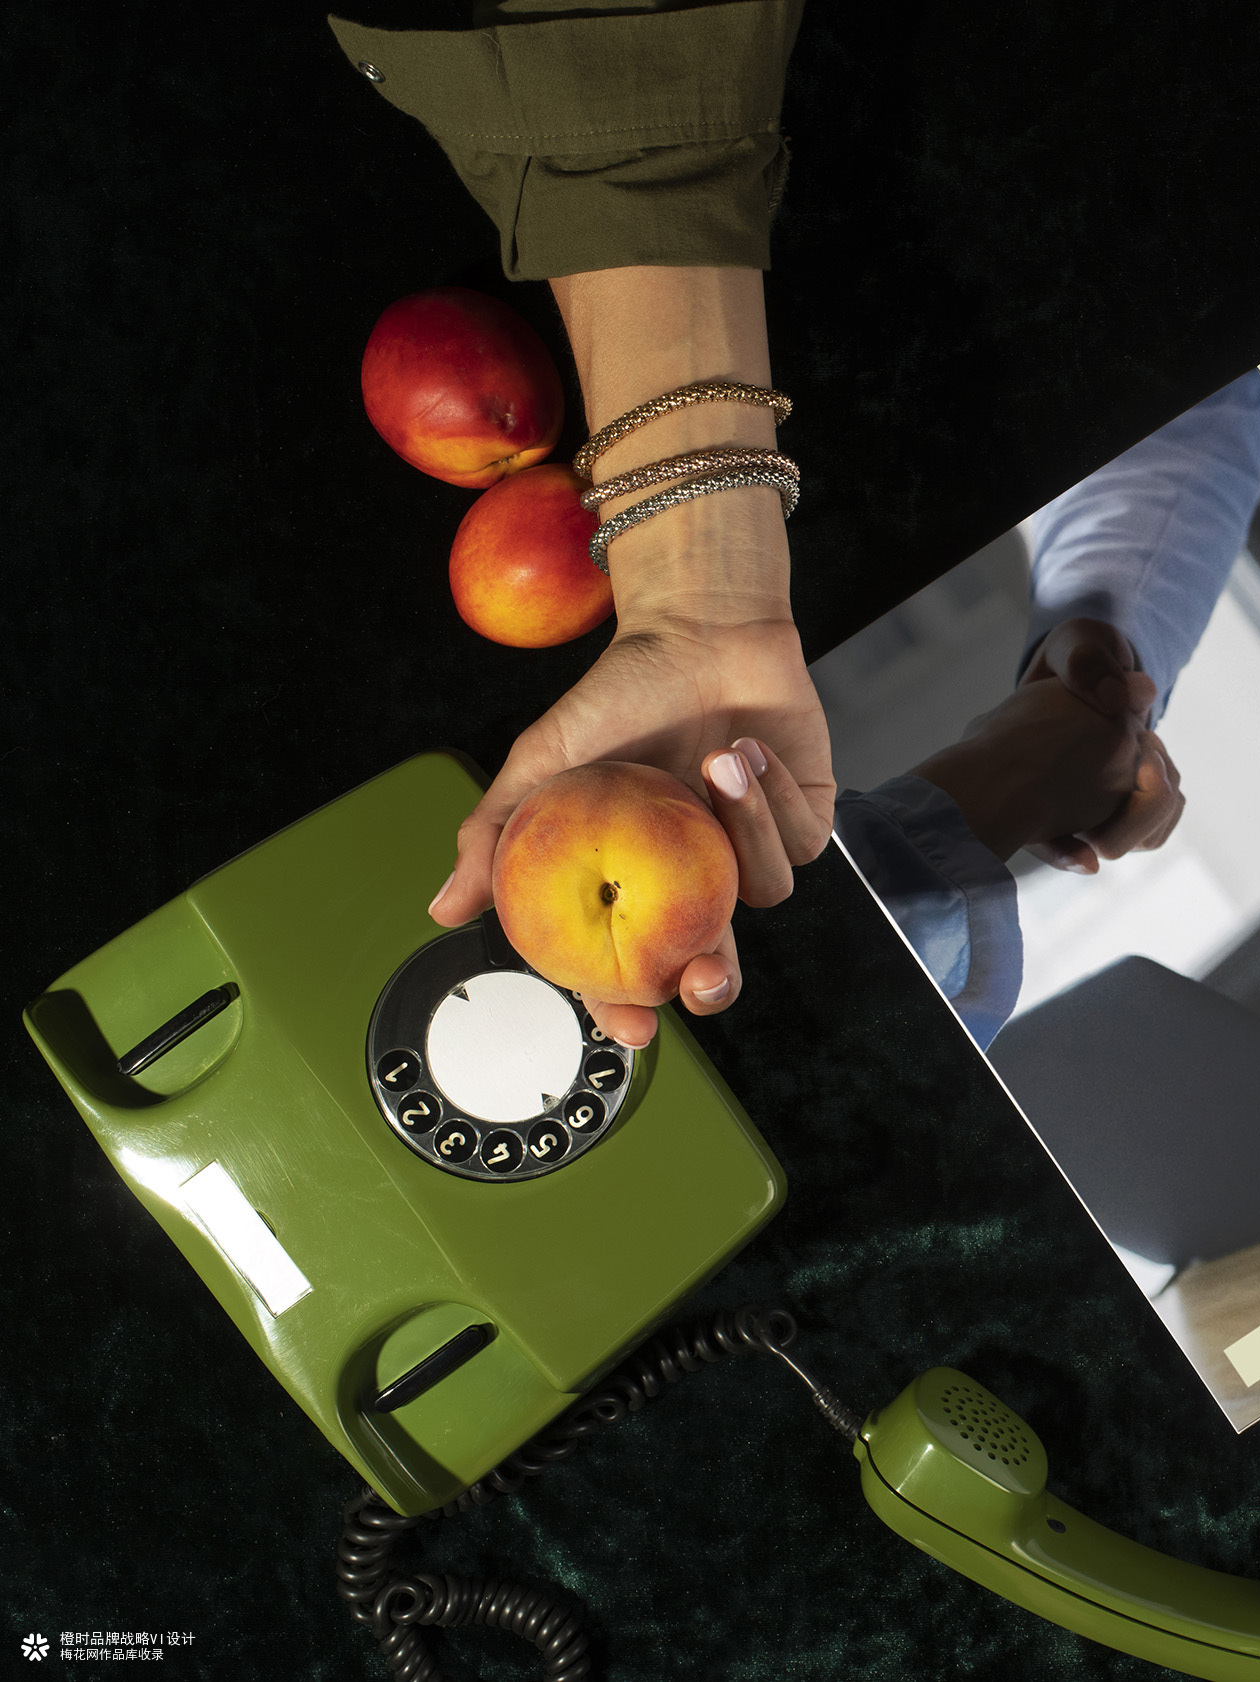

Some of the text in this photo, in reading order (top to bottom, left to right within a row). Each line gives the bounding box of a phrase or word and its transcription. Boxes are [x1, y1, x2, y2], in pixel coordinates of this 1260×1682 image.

[385, 1062, 616, 1164] 1 2 3 4 5 6 7
